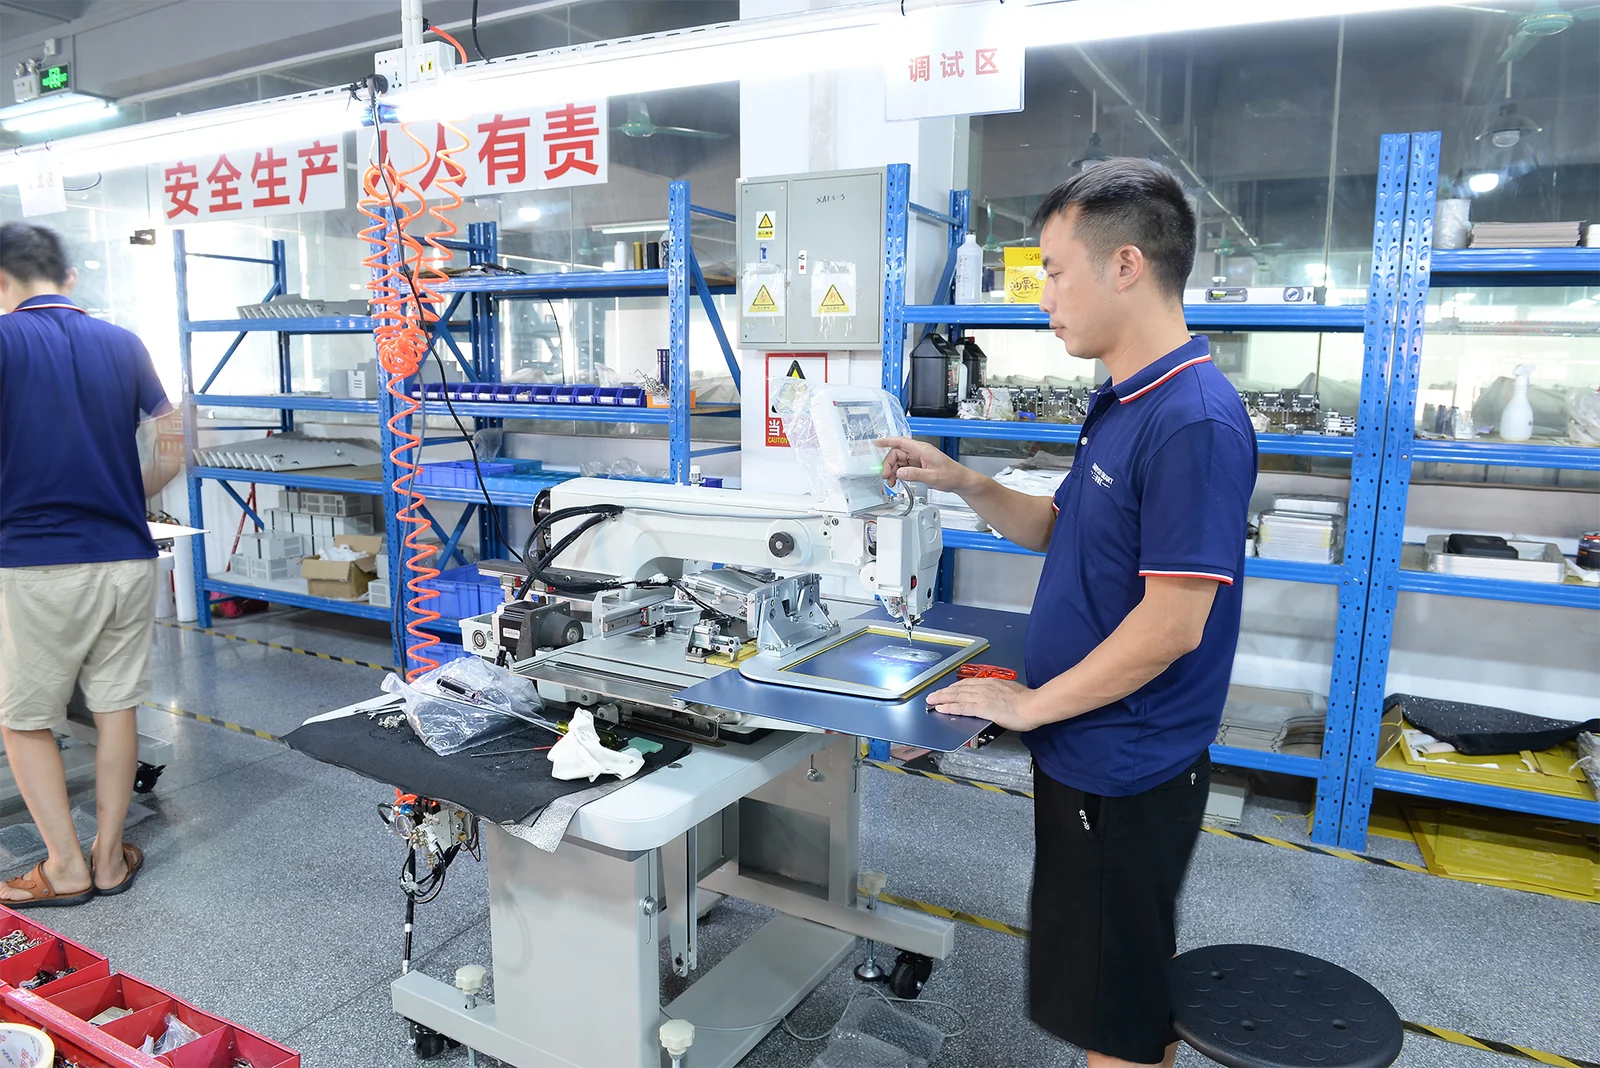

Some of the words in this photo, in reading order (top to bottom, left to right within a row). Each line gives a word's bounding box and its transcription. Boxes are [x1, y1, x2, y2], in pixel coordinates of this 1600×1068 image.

[908, 47, 998, 83] 调试区
[164, 140, 338, 219] 安全生产
